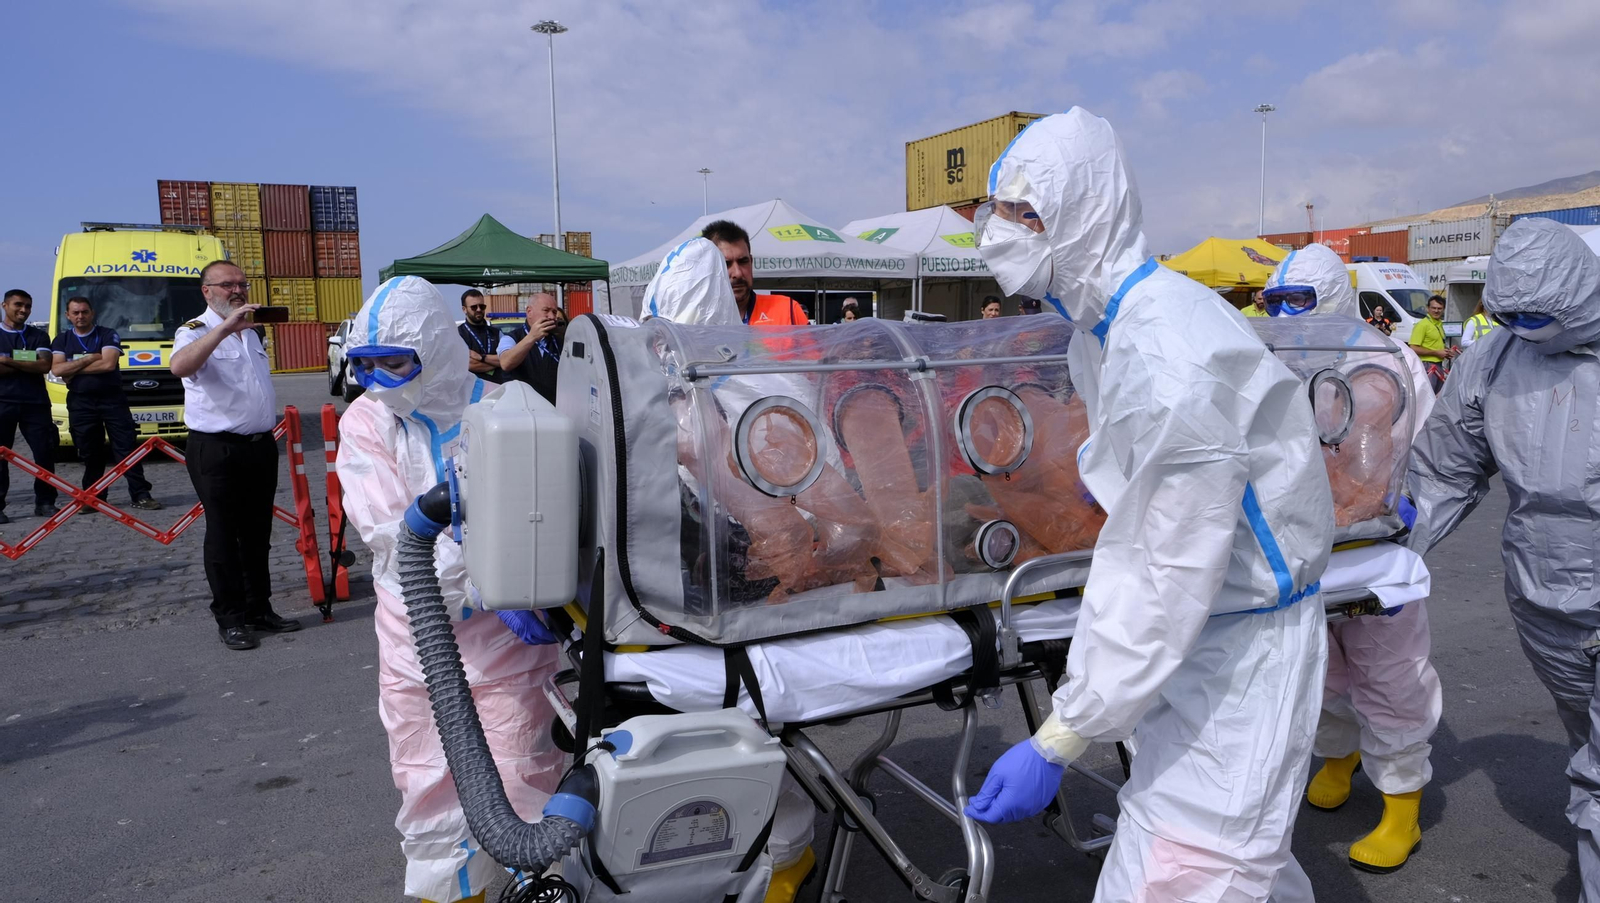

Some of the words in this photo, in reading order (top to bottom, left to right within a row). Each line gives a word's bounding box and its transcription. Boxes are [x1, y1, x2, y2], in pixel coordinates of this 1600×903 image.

[775, 228, 803, 236] 112
[1429, 231, 1481, 245] MAERSK
[754, 257, 792, 269] UESTO
[795, 256, 842, 269] MANDO
[845, 258, 905, 270] AVANZADO
[921, 257, 960, 272] PUESTO
[963, 258, 976, 271] DE
[979, 259, 990, 272] M
[1429, 274, 1447, 283] MA
[1471, 270, 1486, 280] Pu
[1548, 385, 1577, 414] M
[134, 412, 153, 422] 342
[155, 411, 175, 421] LRR
[1570, 418, 1580, 432] 2
